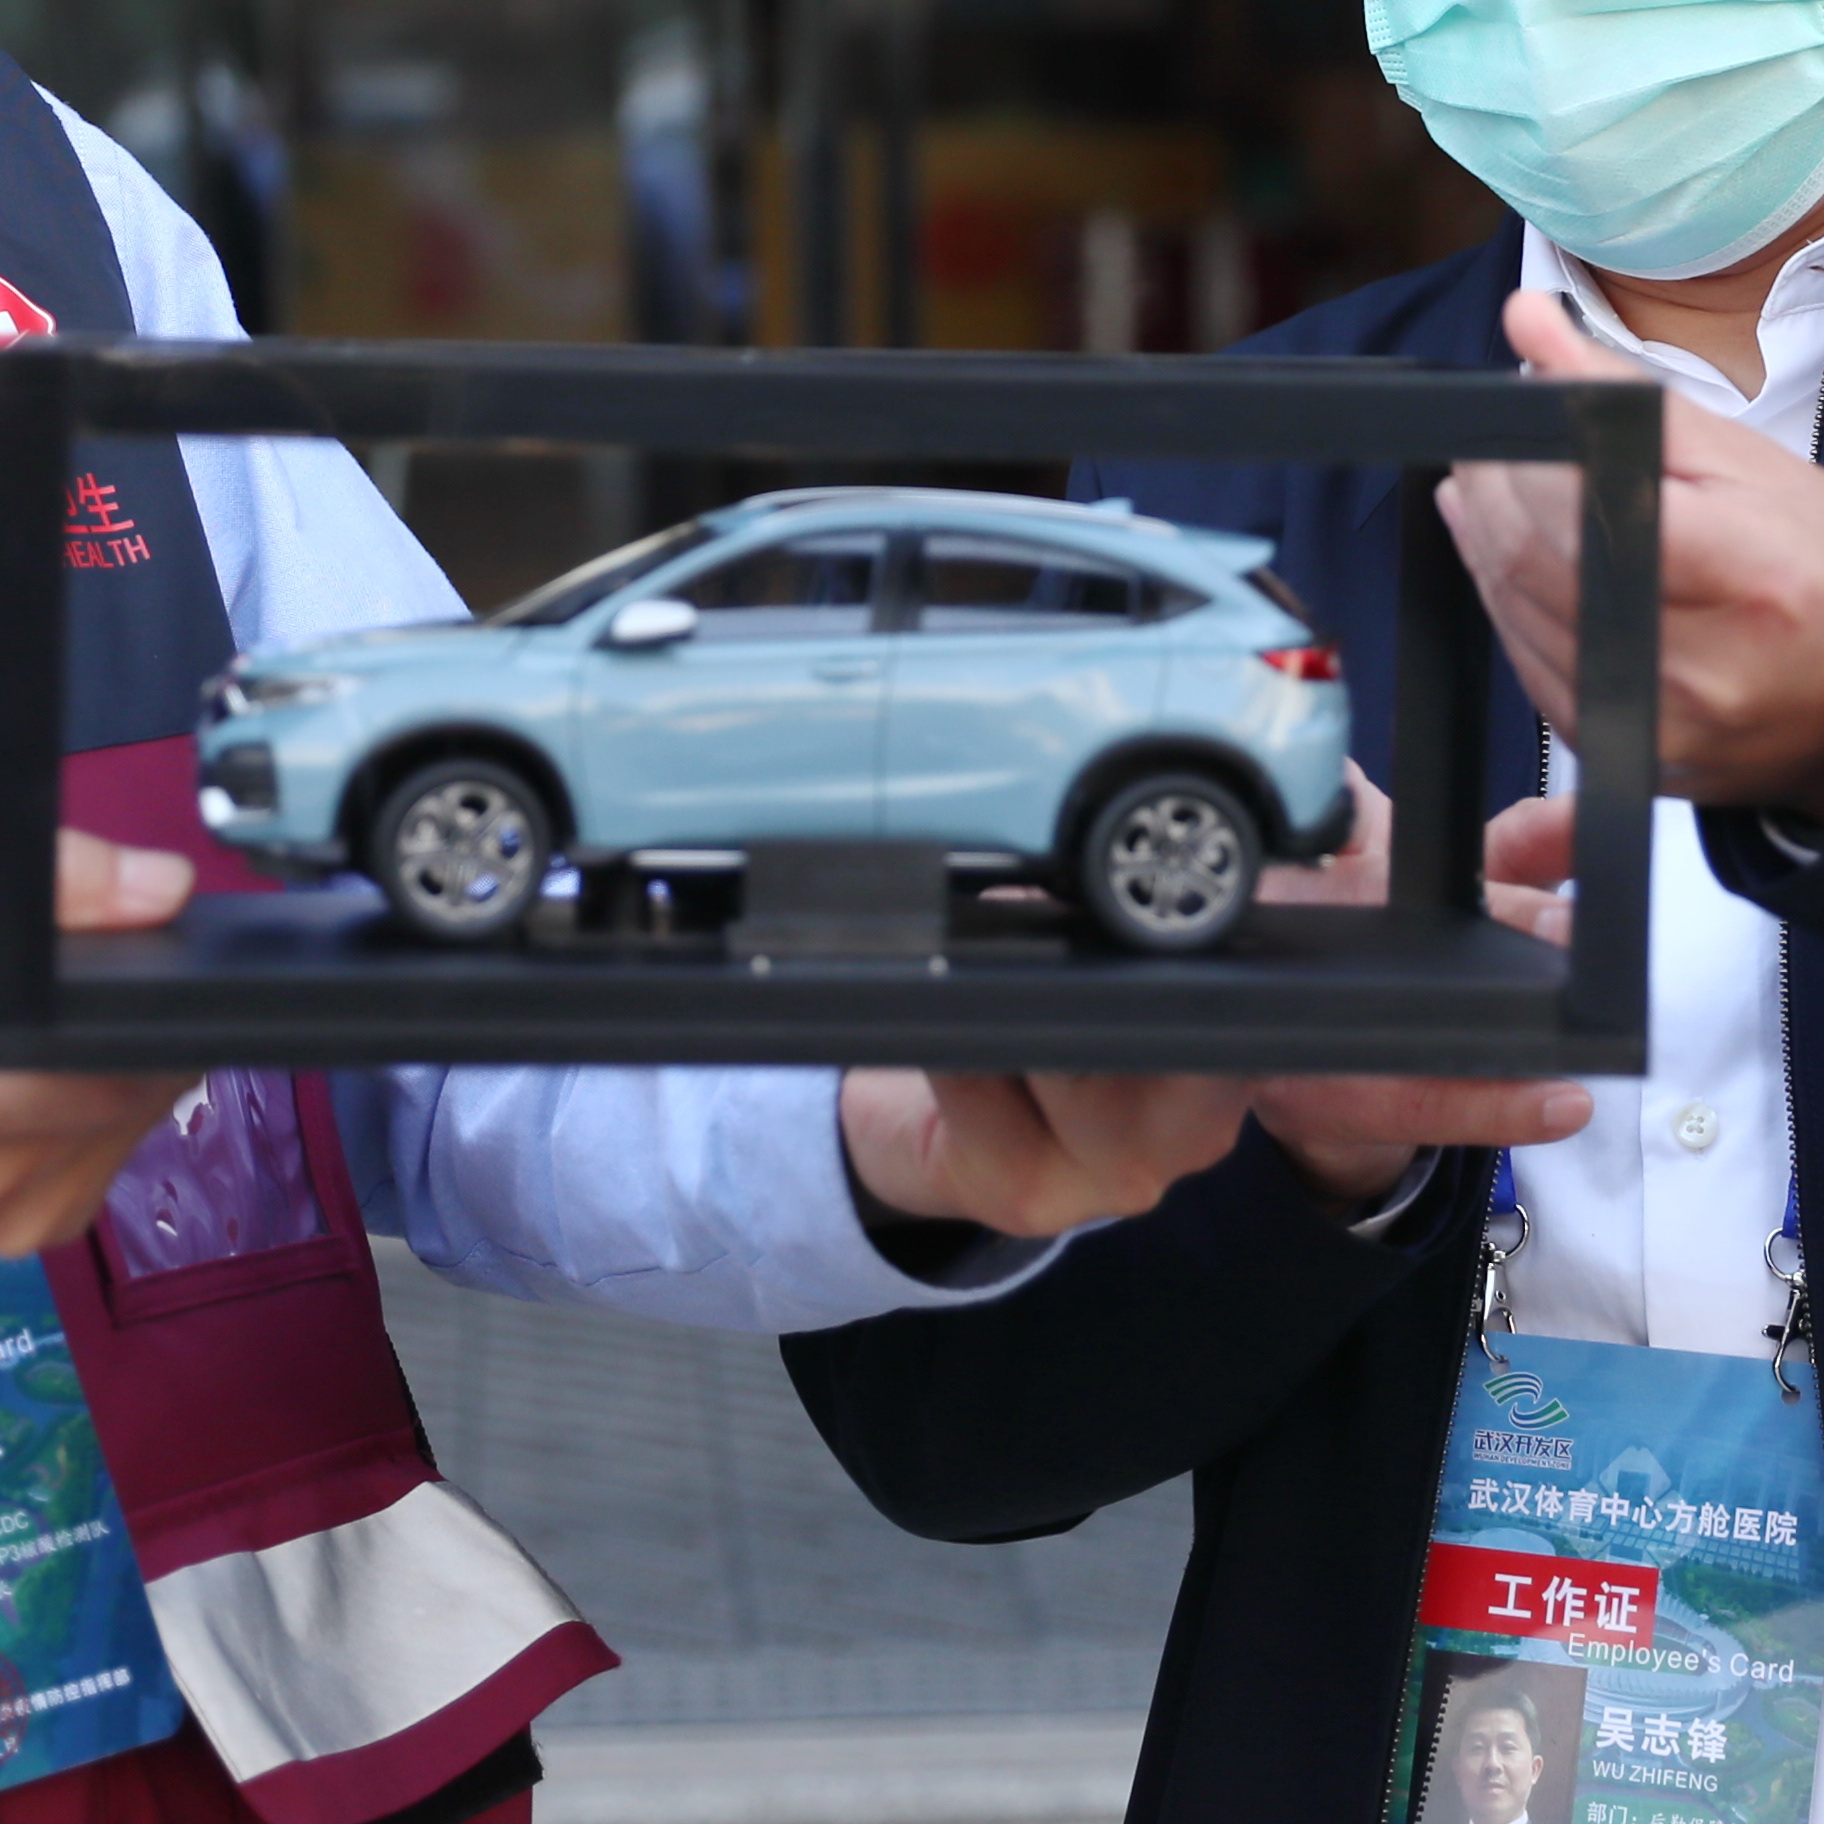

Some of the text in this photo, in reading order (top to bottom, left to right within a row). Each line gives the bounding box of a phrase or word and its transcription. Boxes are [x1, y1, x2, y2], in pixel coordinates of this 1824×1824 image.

[1474, 1430, 1574, 1460] 武汉开发区
[1468, 1477, 1798, 1546] 武汉体育中心方舱医院
[1488, 1573, 1640, 1634] 工作证
[1567, 1633, 1794, 1682] Employee's Card
[1595, 1706, 1727, 1764] 吴志锋
[1592, 1759, 1719, 1792] WU ZHIFENG
